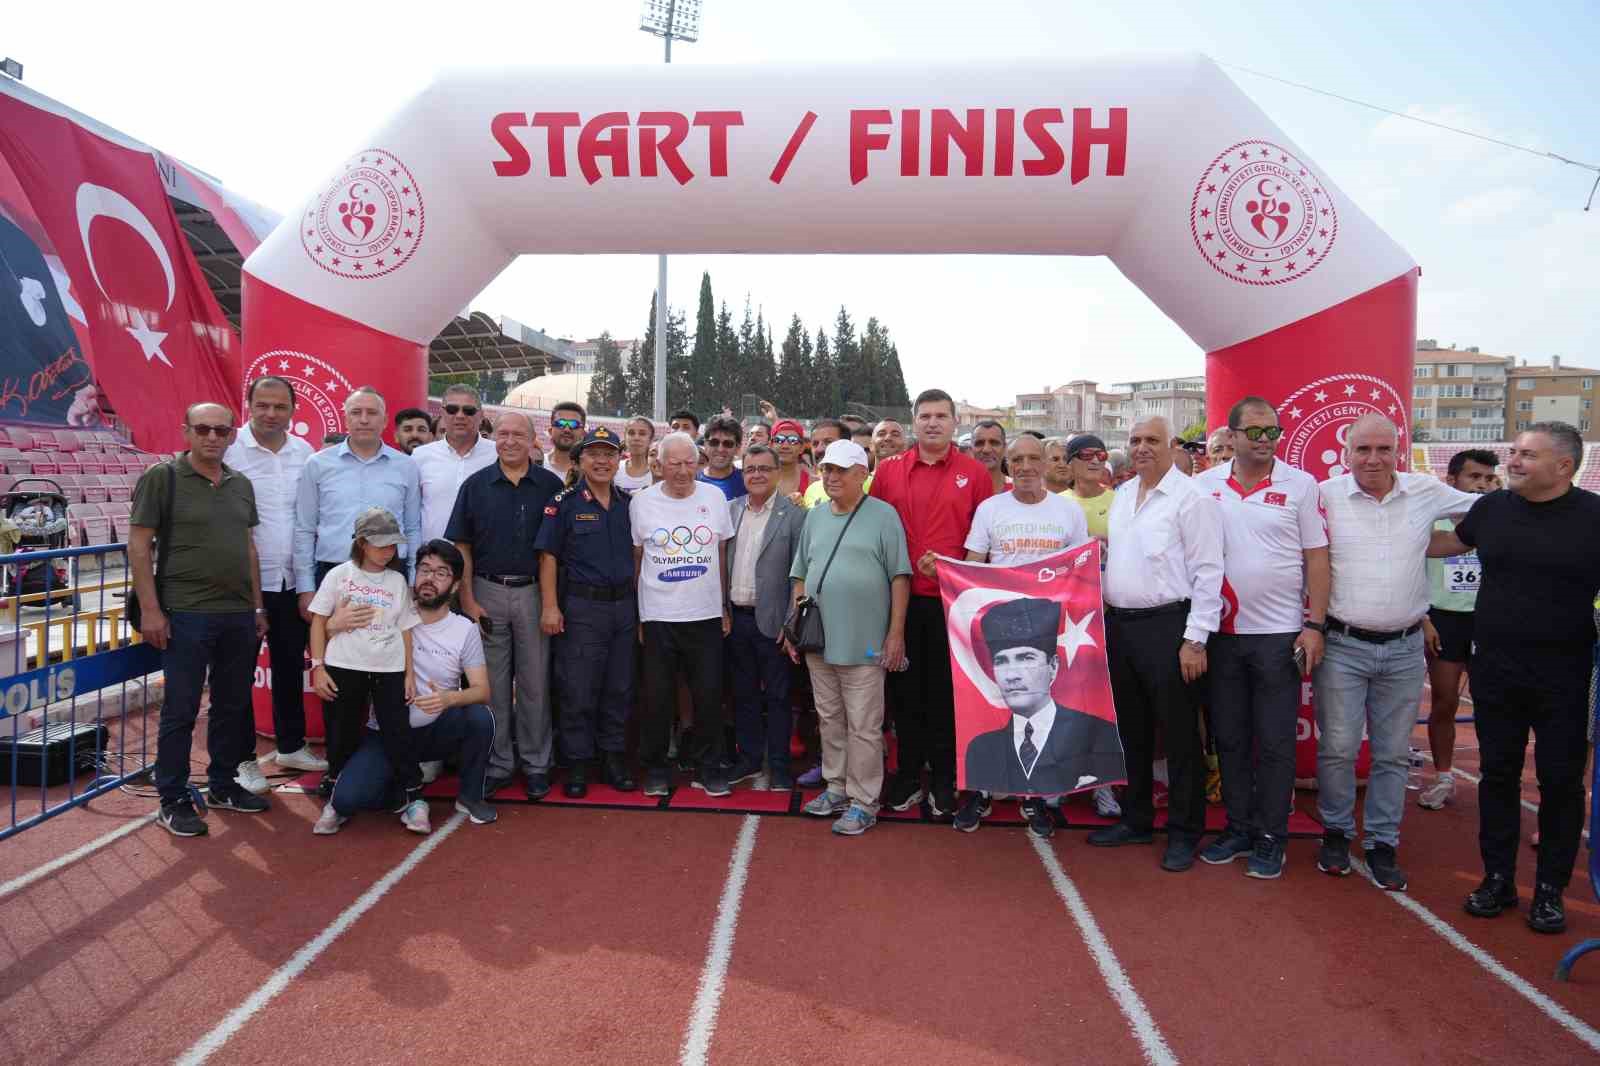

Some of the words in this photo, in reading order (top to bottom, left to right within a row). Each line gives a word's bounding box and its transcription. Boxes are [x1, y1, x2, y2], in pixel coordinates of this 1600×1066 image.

[491, 111, 744, 186] START
[769, 110, 818, 185] /
[850, 108, 1128, 186] FINISH
[313, 393, 326, 407] VE
[322, 406, 337, 433] SPOR
[652, 556, 694, 565] OLYMPIC
[697, 555, 712, 564] DAY
[1453, 570, 1481, 583] 36
[0, 667, 76, 716] OLİS
